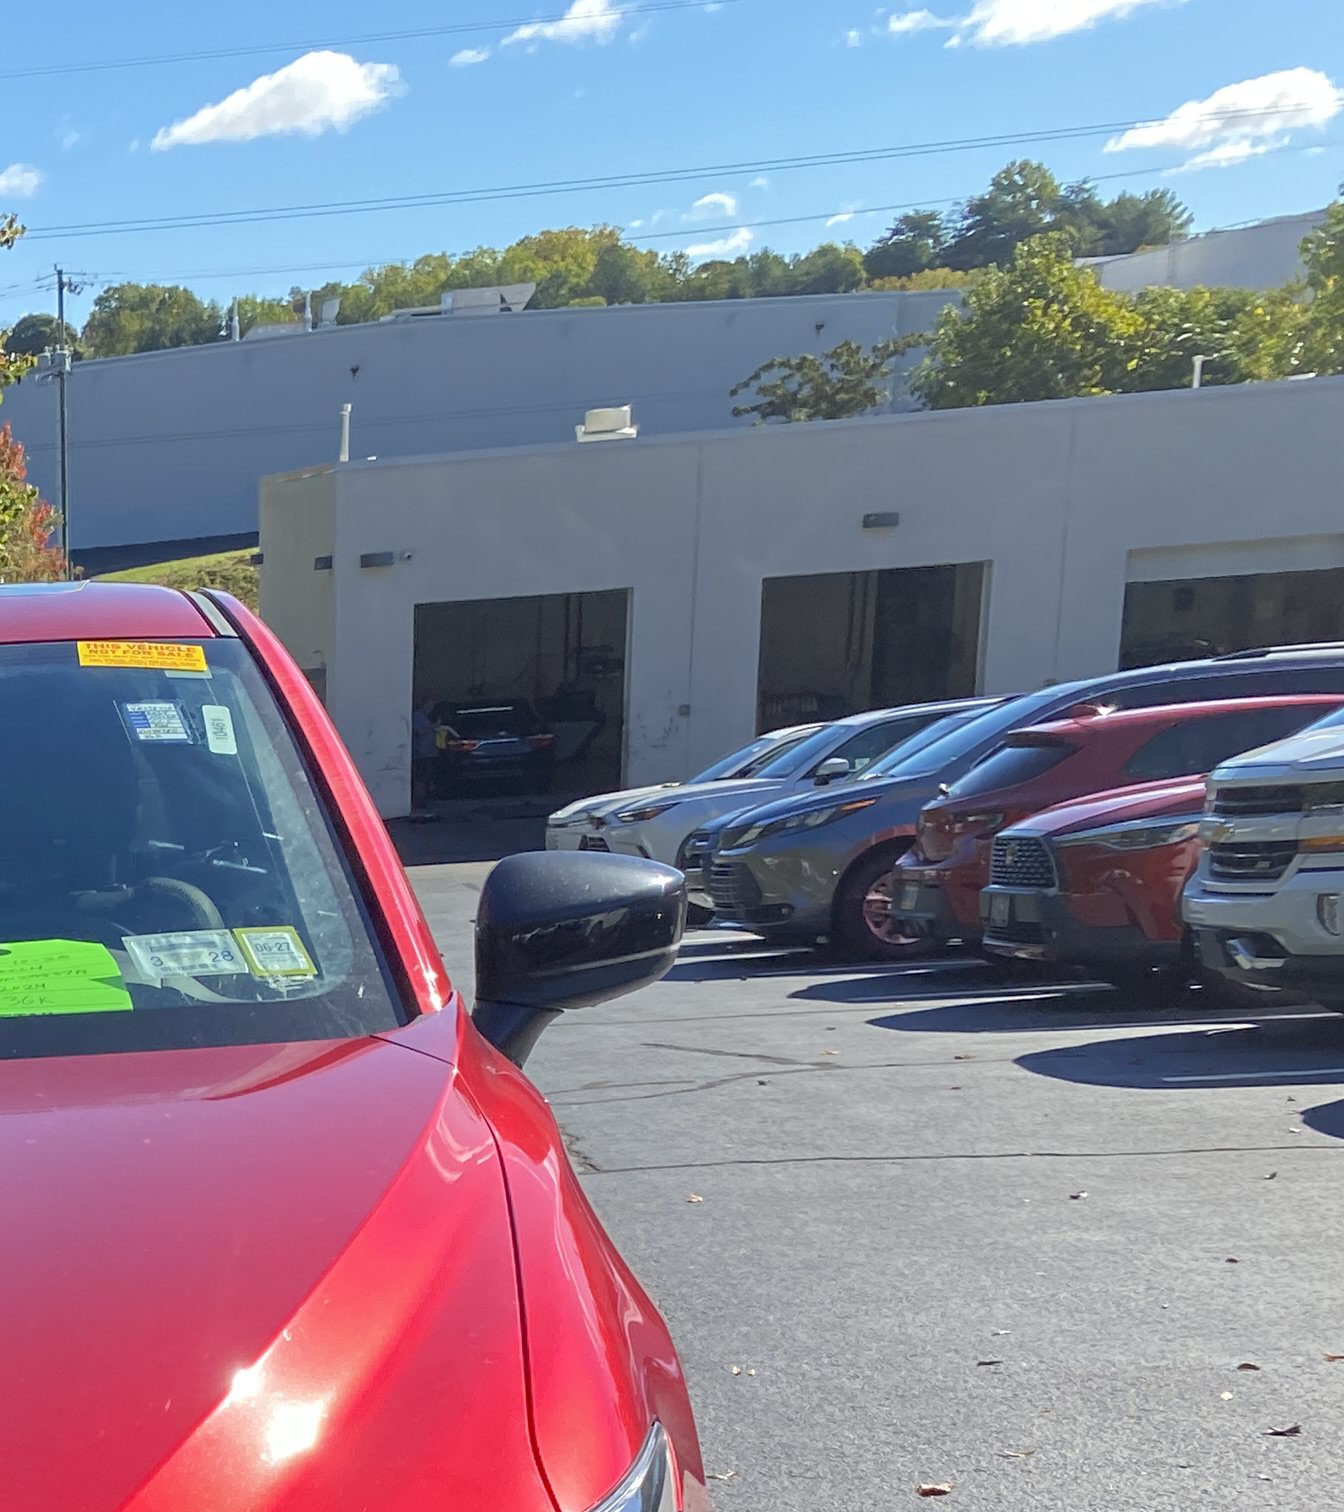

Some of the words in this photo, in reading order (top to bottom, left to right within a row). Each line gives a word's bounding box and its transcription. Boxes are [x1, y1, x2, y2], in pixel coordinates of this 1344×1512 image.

[85, 643, 121, 651] THIS
[126, 643, 196, 654] VEHICLE
[156, 650, 193, 658] SALE
[255, 941, 291, 953] 06-27
[150, 956, 164, 967] 3
[208, 950, 234, 963] 28
